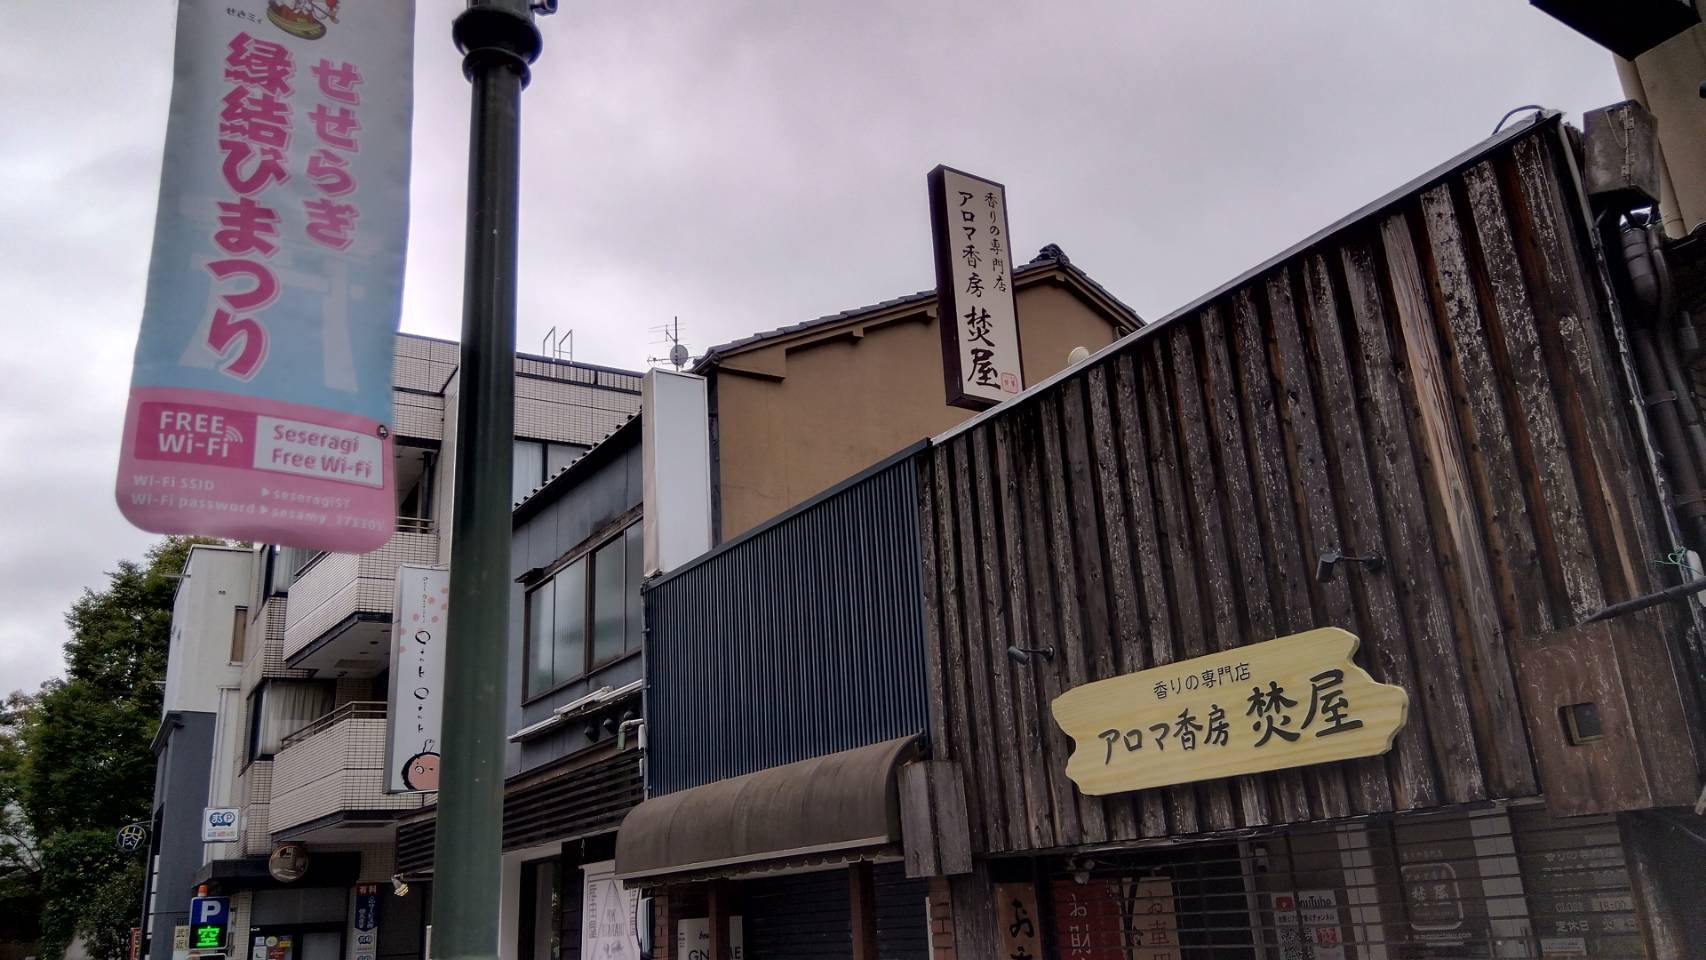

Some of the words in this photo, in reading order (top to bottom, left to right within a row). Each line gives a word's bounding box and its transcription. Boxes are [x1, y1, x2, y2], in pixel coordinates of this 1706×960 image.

[303, 58, 363, 250] せせらぎ
[204, 31, 295, 381] 縁結びまつり
[958, 191, 985, 298] アロマ香房
[985, 192, 1007, 293] 香りの専門店
[160, 411, 224, 435] FREE
[158, 433, 229, 458] Wi-Fi
[272, 424, 360, 455] Seseragi
[272, 447, 316, 470] Free
[321, 455, 373, 479] Wi-Fi
[133, 475, 176, 488] Wi-Fi
[181, 478, 215, 491] SSID
[131, 493, 174, 506] Wi-Fi
[178, 497, 256, 514] password
[1153, 662, 1251, 700] 香りの専門店
[1098, 704, 1230, 765] アロマ香房
[200, 901, 221, 923] P
[196, 925, 221, 947] 空
